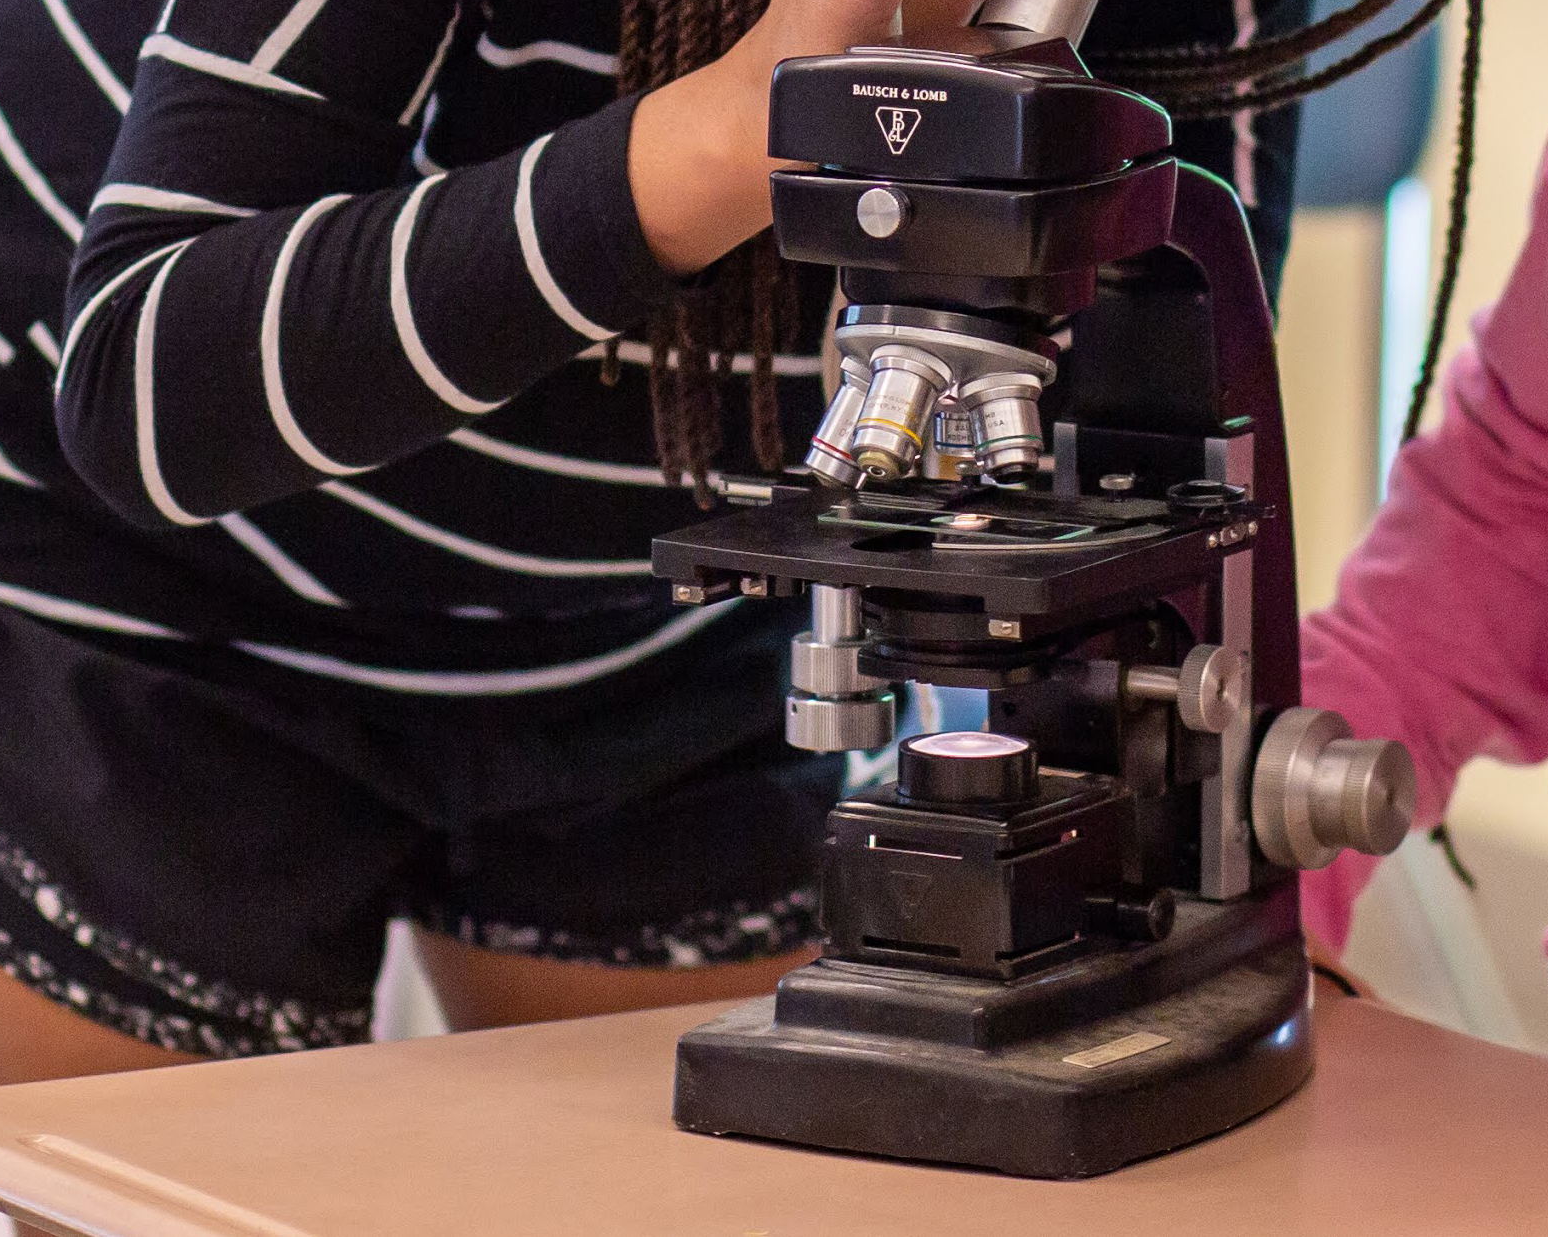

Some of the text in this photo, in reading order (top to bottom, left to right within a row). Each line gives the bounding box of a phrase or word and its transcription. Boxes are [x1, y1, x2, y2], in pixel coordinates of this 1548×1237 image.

[853, 84, 947, 102] BAUSCH & LOMB
